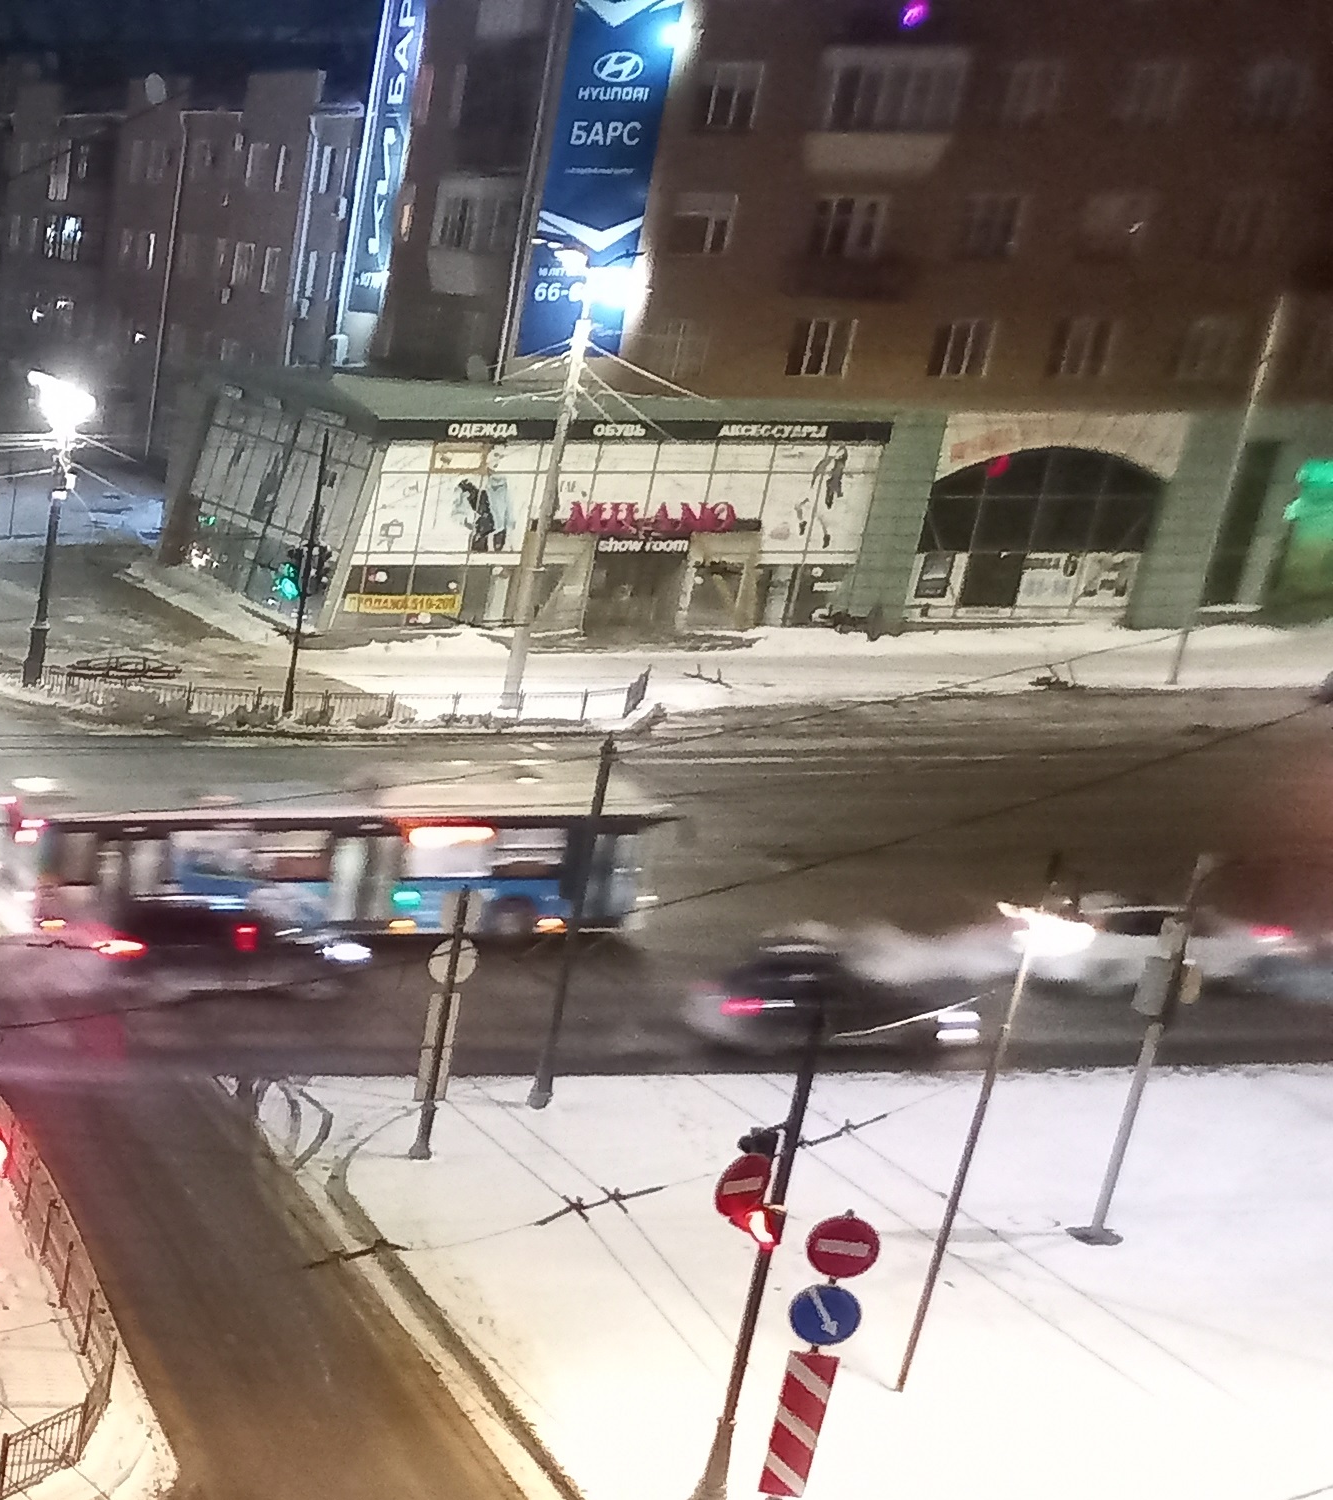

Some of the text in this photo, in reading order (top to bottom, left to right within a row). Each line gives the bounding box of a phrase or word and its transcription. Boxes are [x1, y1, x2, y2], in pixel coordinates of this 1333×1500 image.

[577, 86, 650, 102] HYUNDAI
[569, 121, 643, 146] БАРС
[447, 422, 829, 438] ОДЕЖДА ОБУВЬ АКСЕССУАРЫ
[564, 500, 737, 534] MILANO
[597, 536, 690, 553] show room
